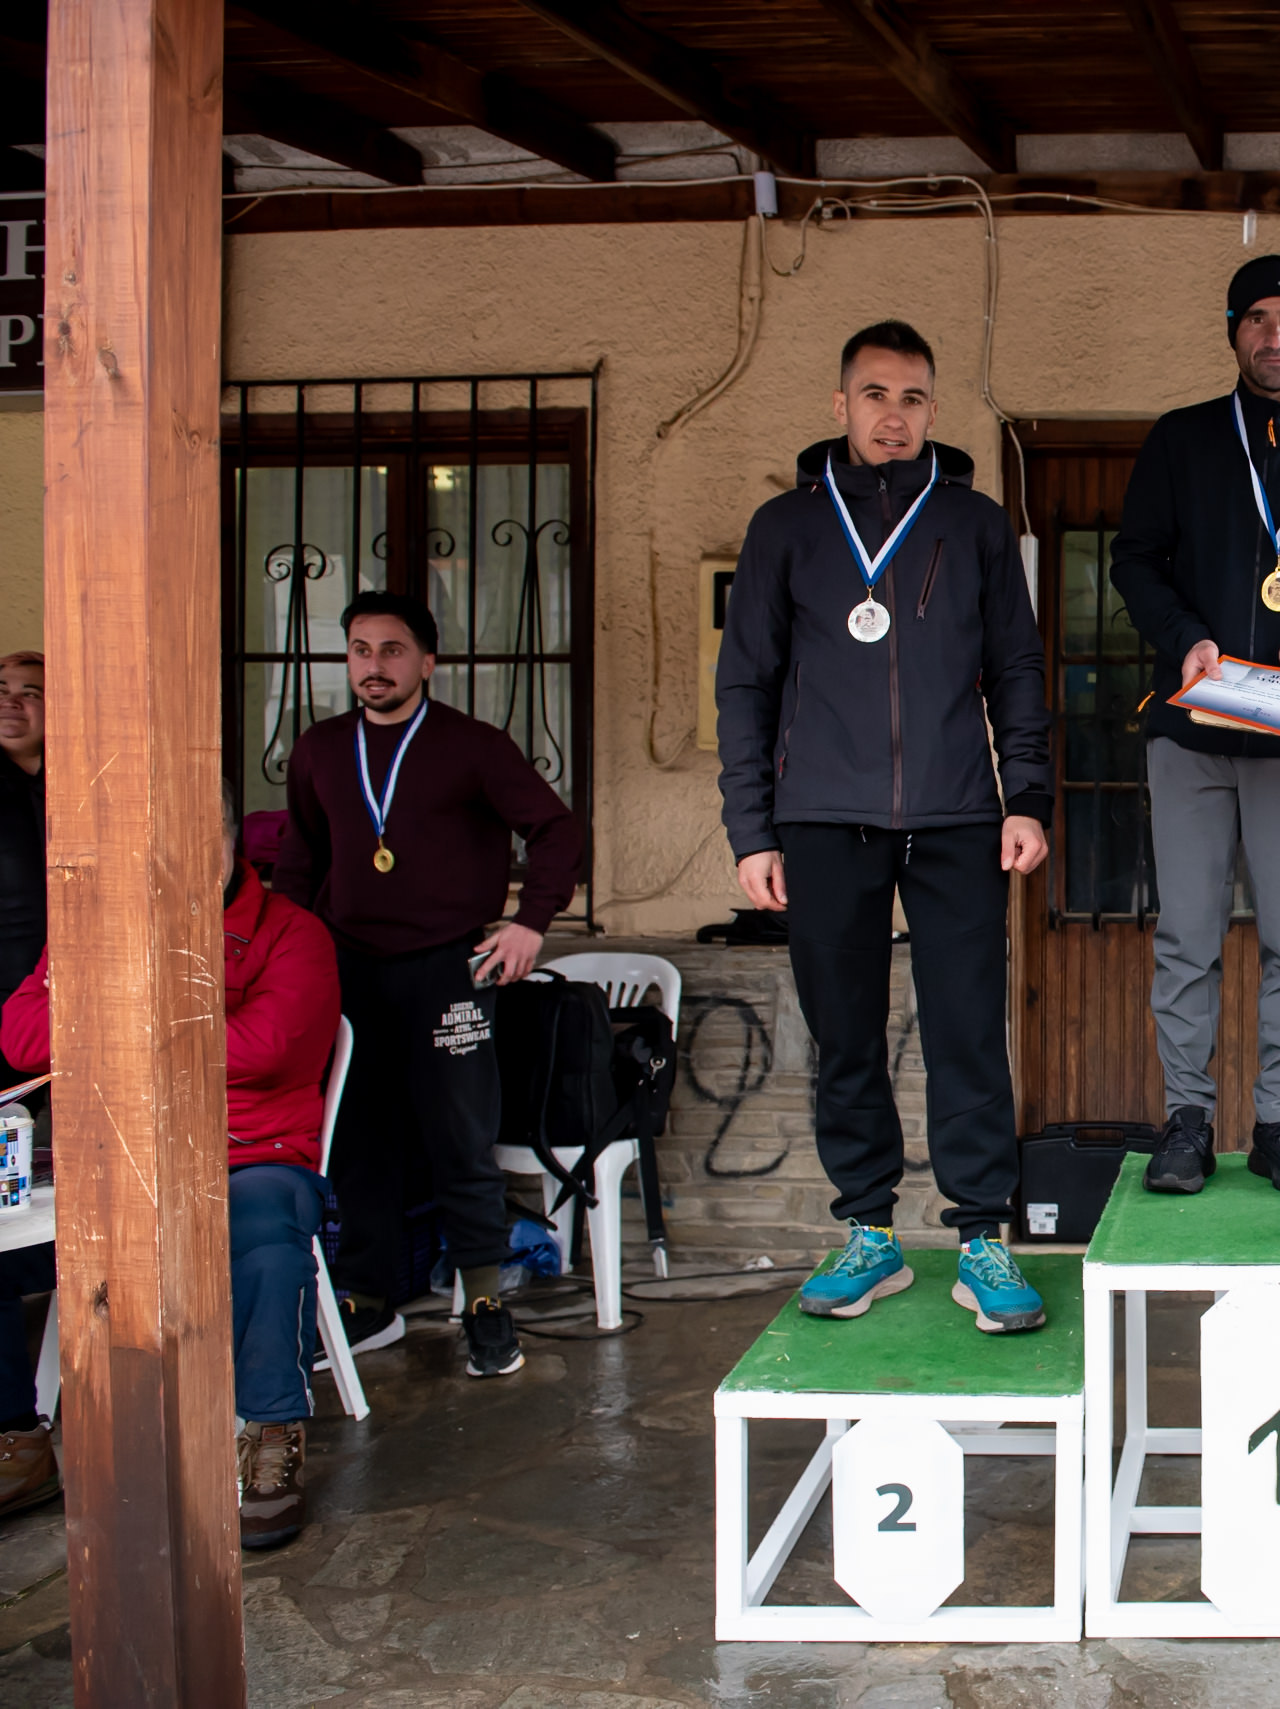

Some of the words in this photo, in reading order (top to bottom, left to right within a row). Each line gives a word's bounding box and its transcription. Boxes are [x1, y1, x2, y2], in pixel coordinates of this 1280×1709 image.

[442, 1008, 483, 1026] ADMIRAL
[434, 1028, 490, 1047] SPORTSWEAR
[875, 1483, 917, 1532] 2
